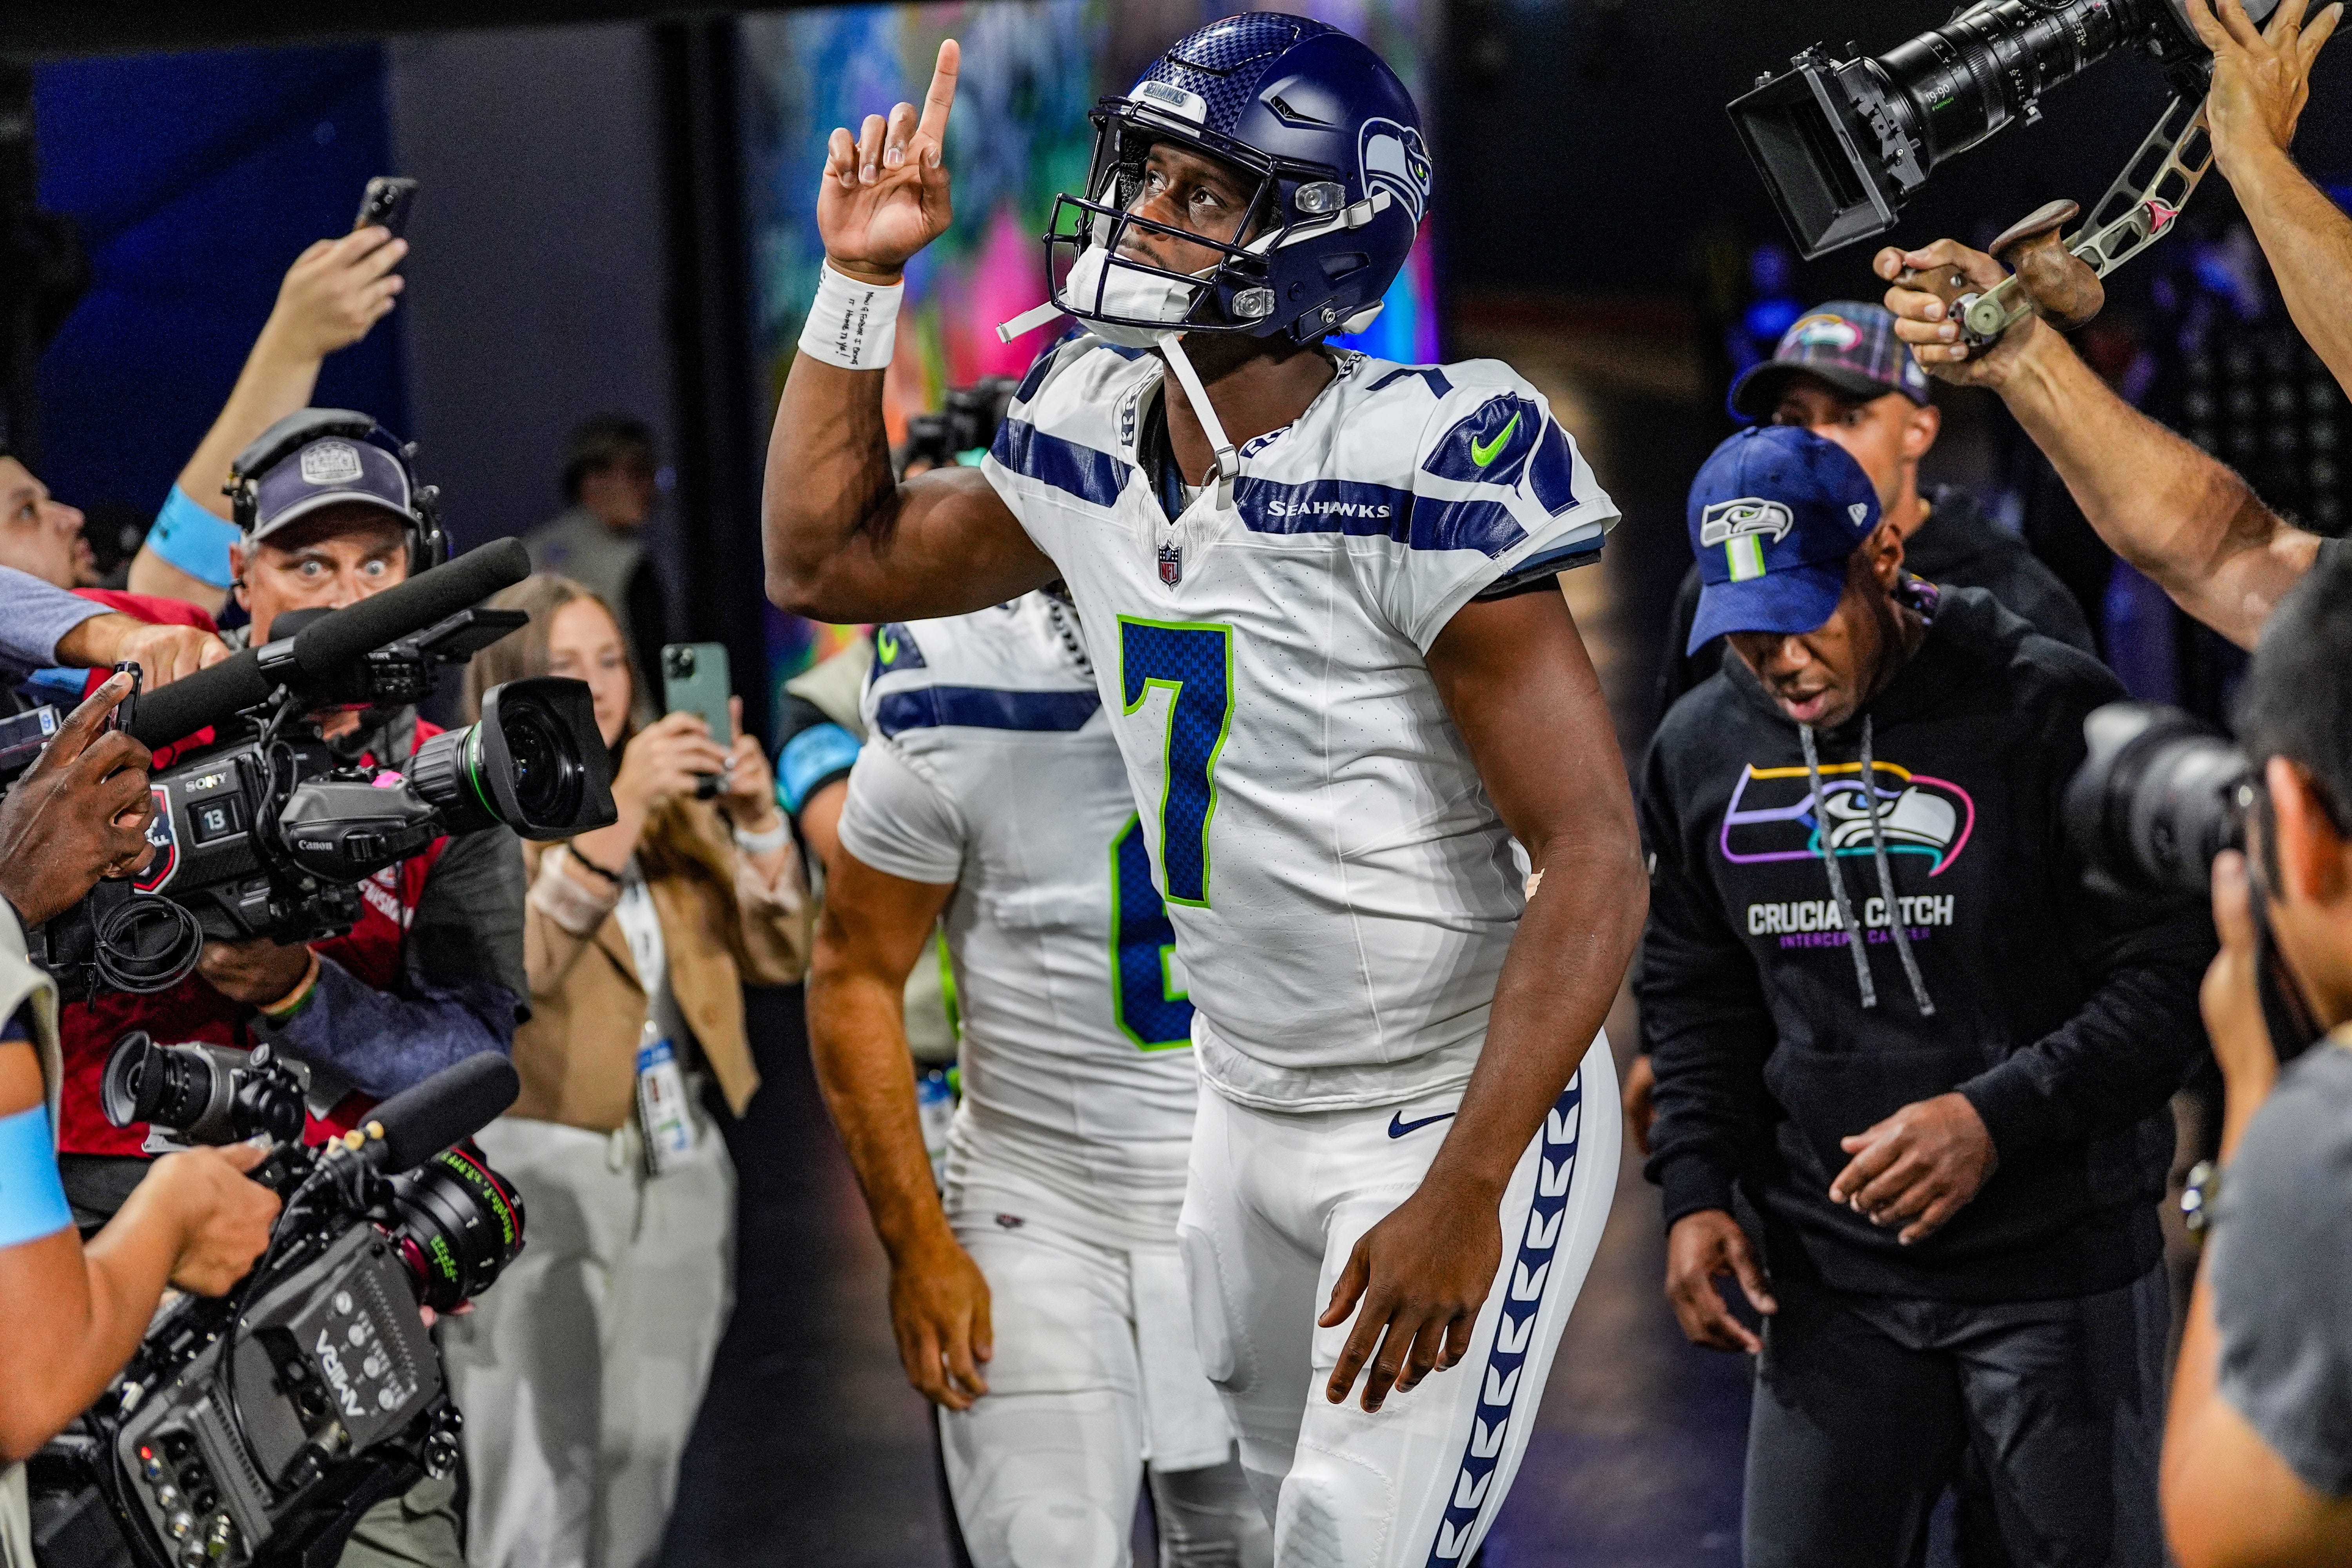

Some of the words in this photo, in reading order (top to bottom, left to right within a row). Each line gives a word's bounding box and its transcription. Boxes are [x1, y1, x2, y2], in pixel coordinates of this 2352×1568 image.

[1144, 82, 1187, 105] SEAHAWKS
[1925, 83, 1950, 103] 19-90
[1267, 499, 1392, 519] SEAHAWKS
[1161, 562, 1178, 581] NFL
[1116, 613, 1234, 909] 7
[185, 771, 228, 793] SONY
[203, 809, 225, 831] 13
[298, 839, 334, 852] Canon
[1748, 899, 1860, 936] CRUCIA
